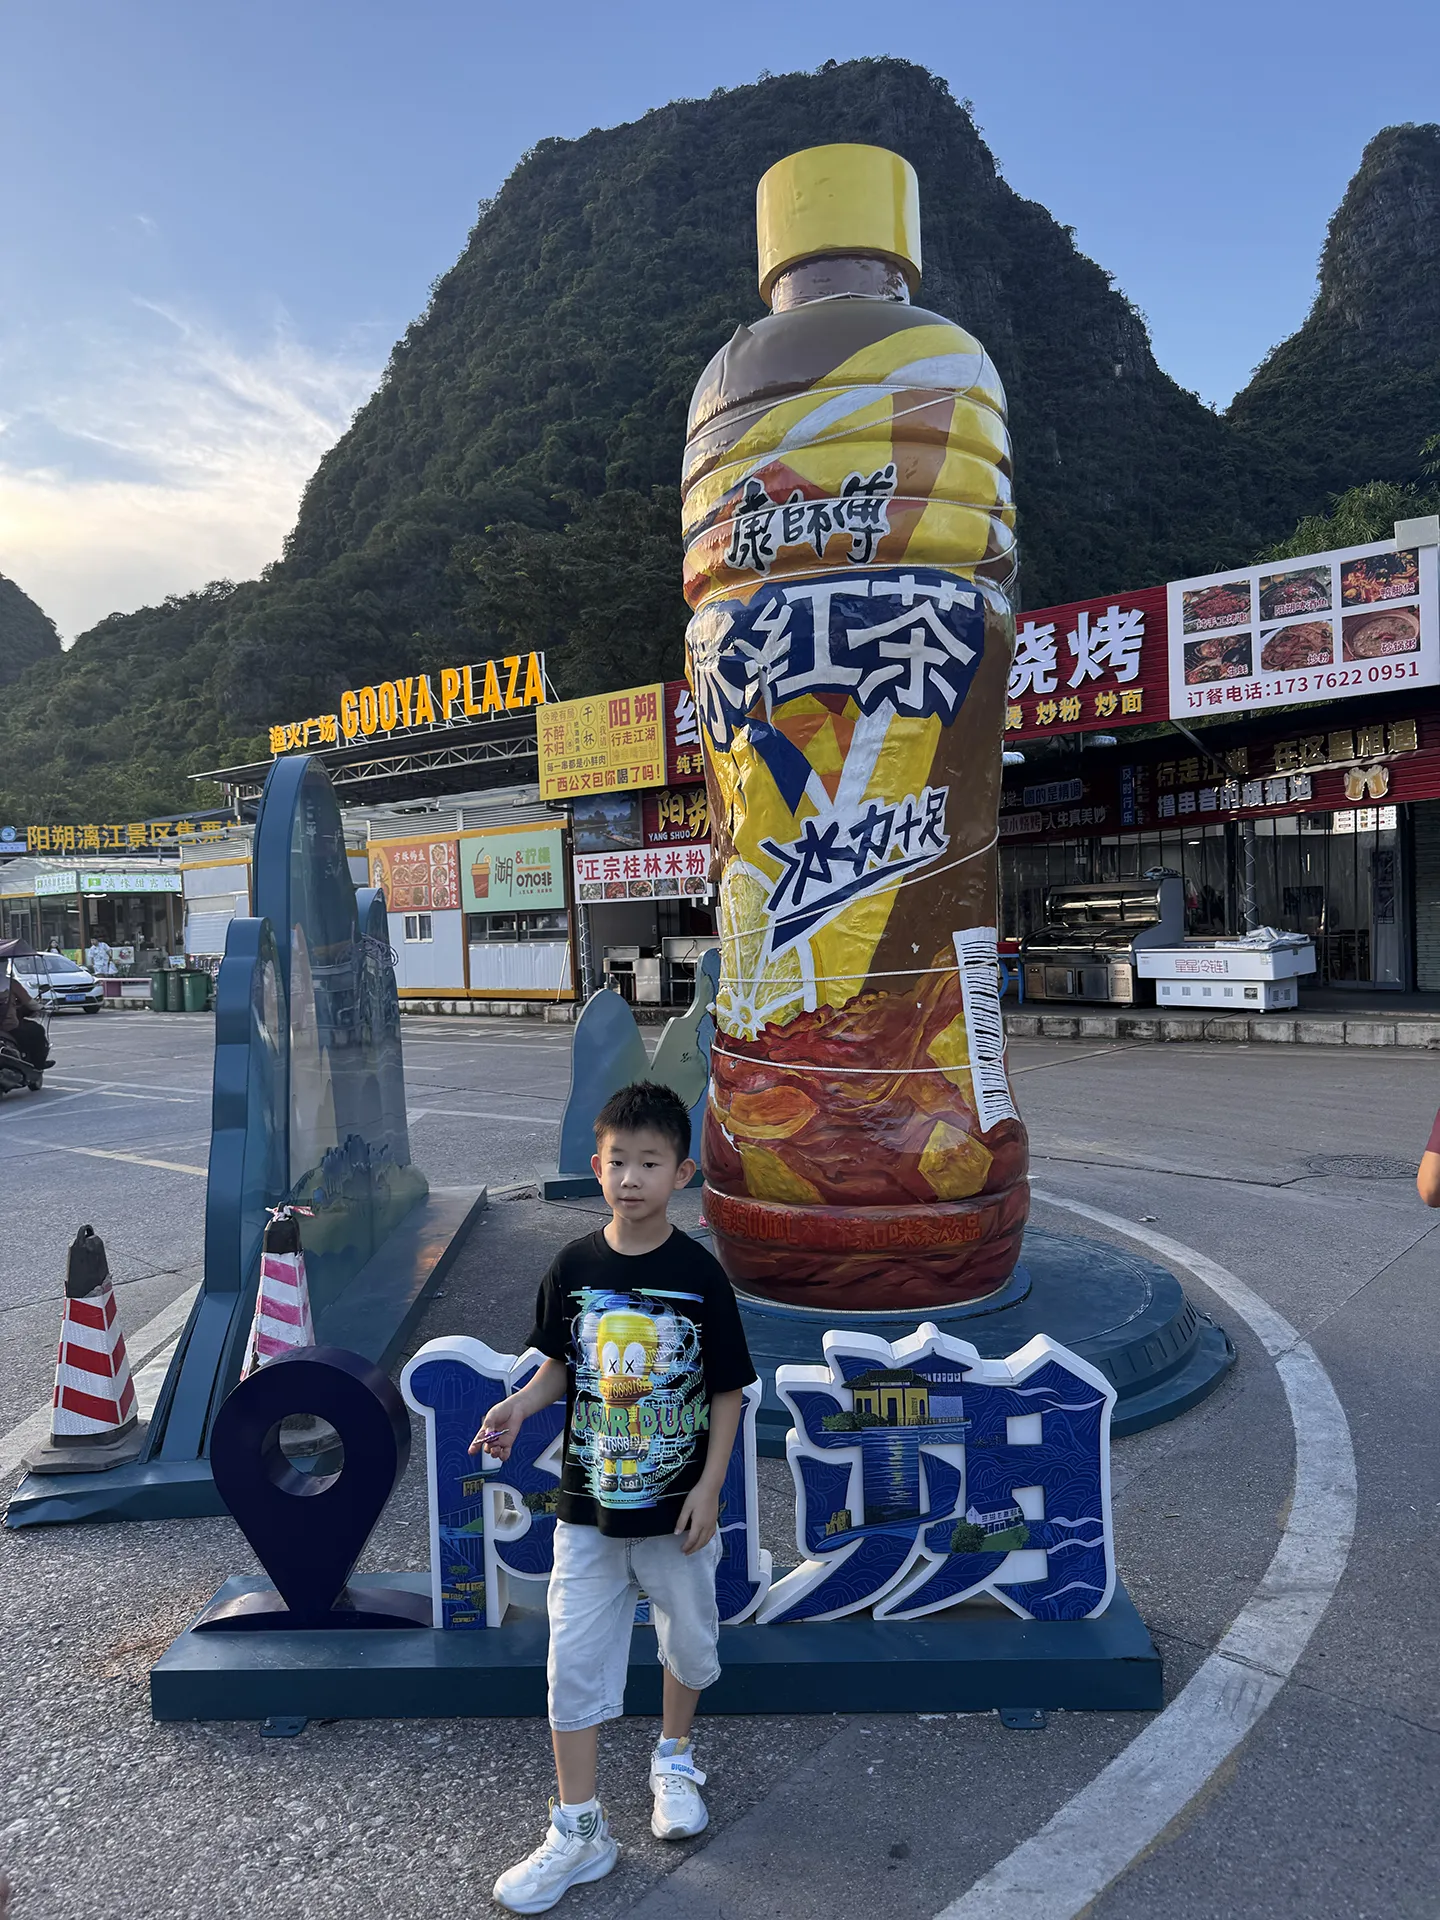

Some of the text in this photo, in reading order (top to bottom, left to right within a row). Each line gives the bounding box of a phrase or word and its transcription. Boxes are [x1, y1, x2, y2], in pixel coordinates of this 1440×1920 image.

[1274, 597, 1328, 616] 阳朔啤酒鱼
[1307, 652, 1330, 665] 炒粉
[1381, 638, 1417, 653] 砂锅粥
[1315, 669, 1362, 691] 7622
[1368, 661, 1420, 683] 0951
[341, 651, 546, 738] GOOYA PLAZA
[609, 692, 657, 729] 阳朔
[1036, 696, 1081, 725] 炒粉
[1095, 688, 1144, 717] 炒面
[269, 714, 336, 754] 渔火广场
[611, 728, 656, 748] 行走江湖
[546, 756, 607, 773] 每一串都是小鲜肉
[1157, 719, 1418, 788] 行走江湖 在这里相遇
[1121, 767, 1134, 823] 及时行乐
[648, 829, 690, 842] YANG SHUO
[759, 790, 946, 912] 冰力十足
[584, 849, 705, 881] 正宗桂林米粉
[1175, 959, 1224, 974] 星星冷链
[639, 1402, 710, 1436] DUCK
